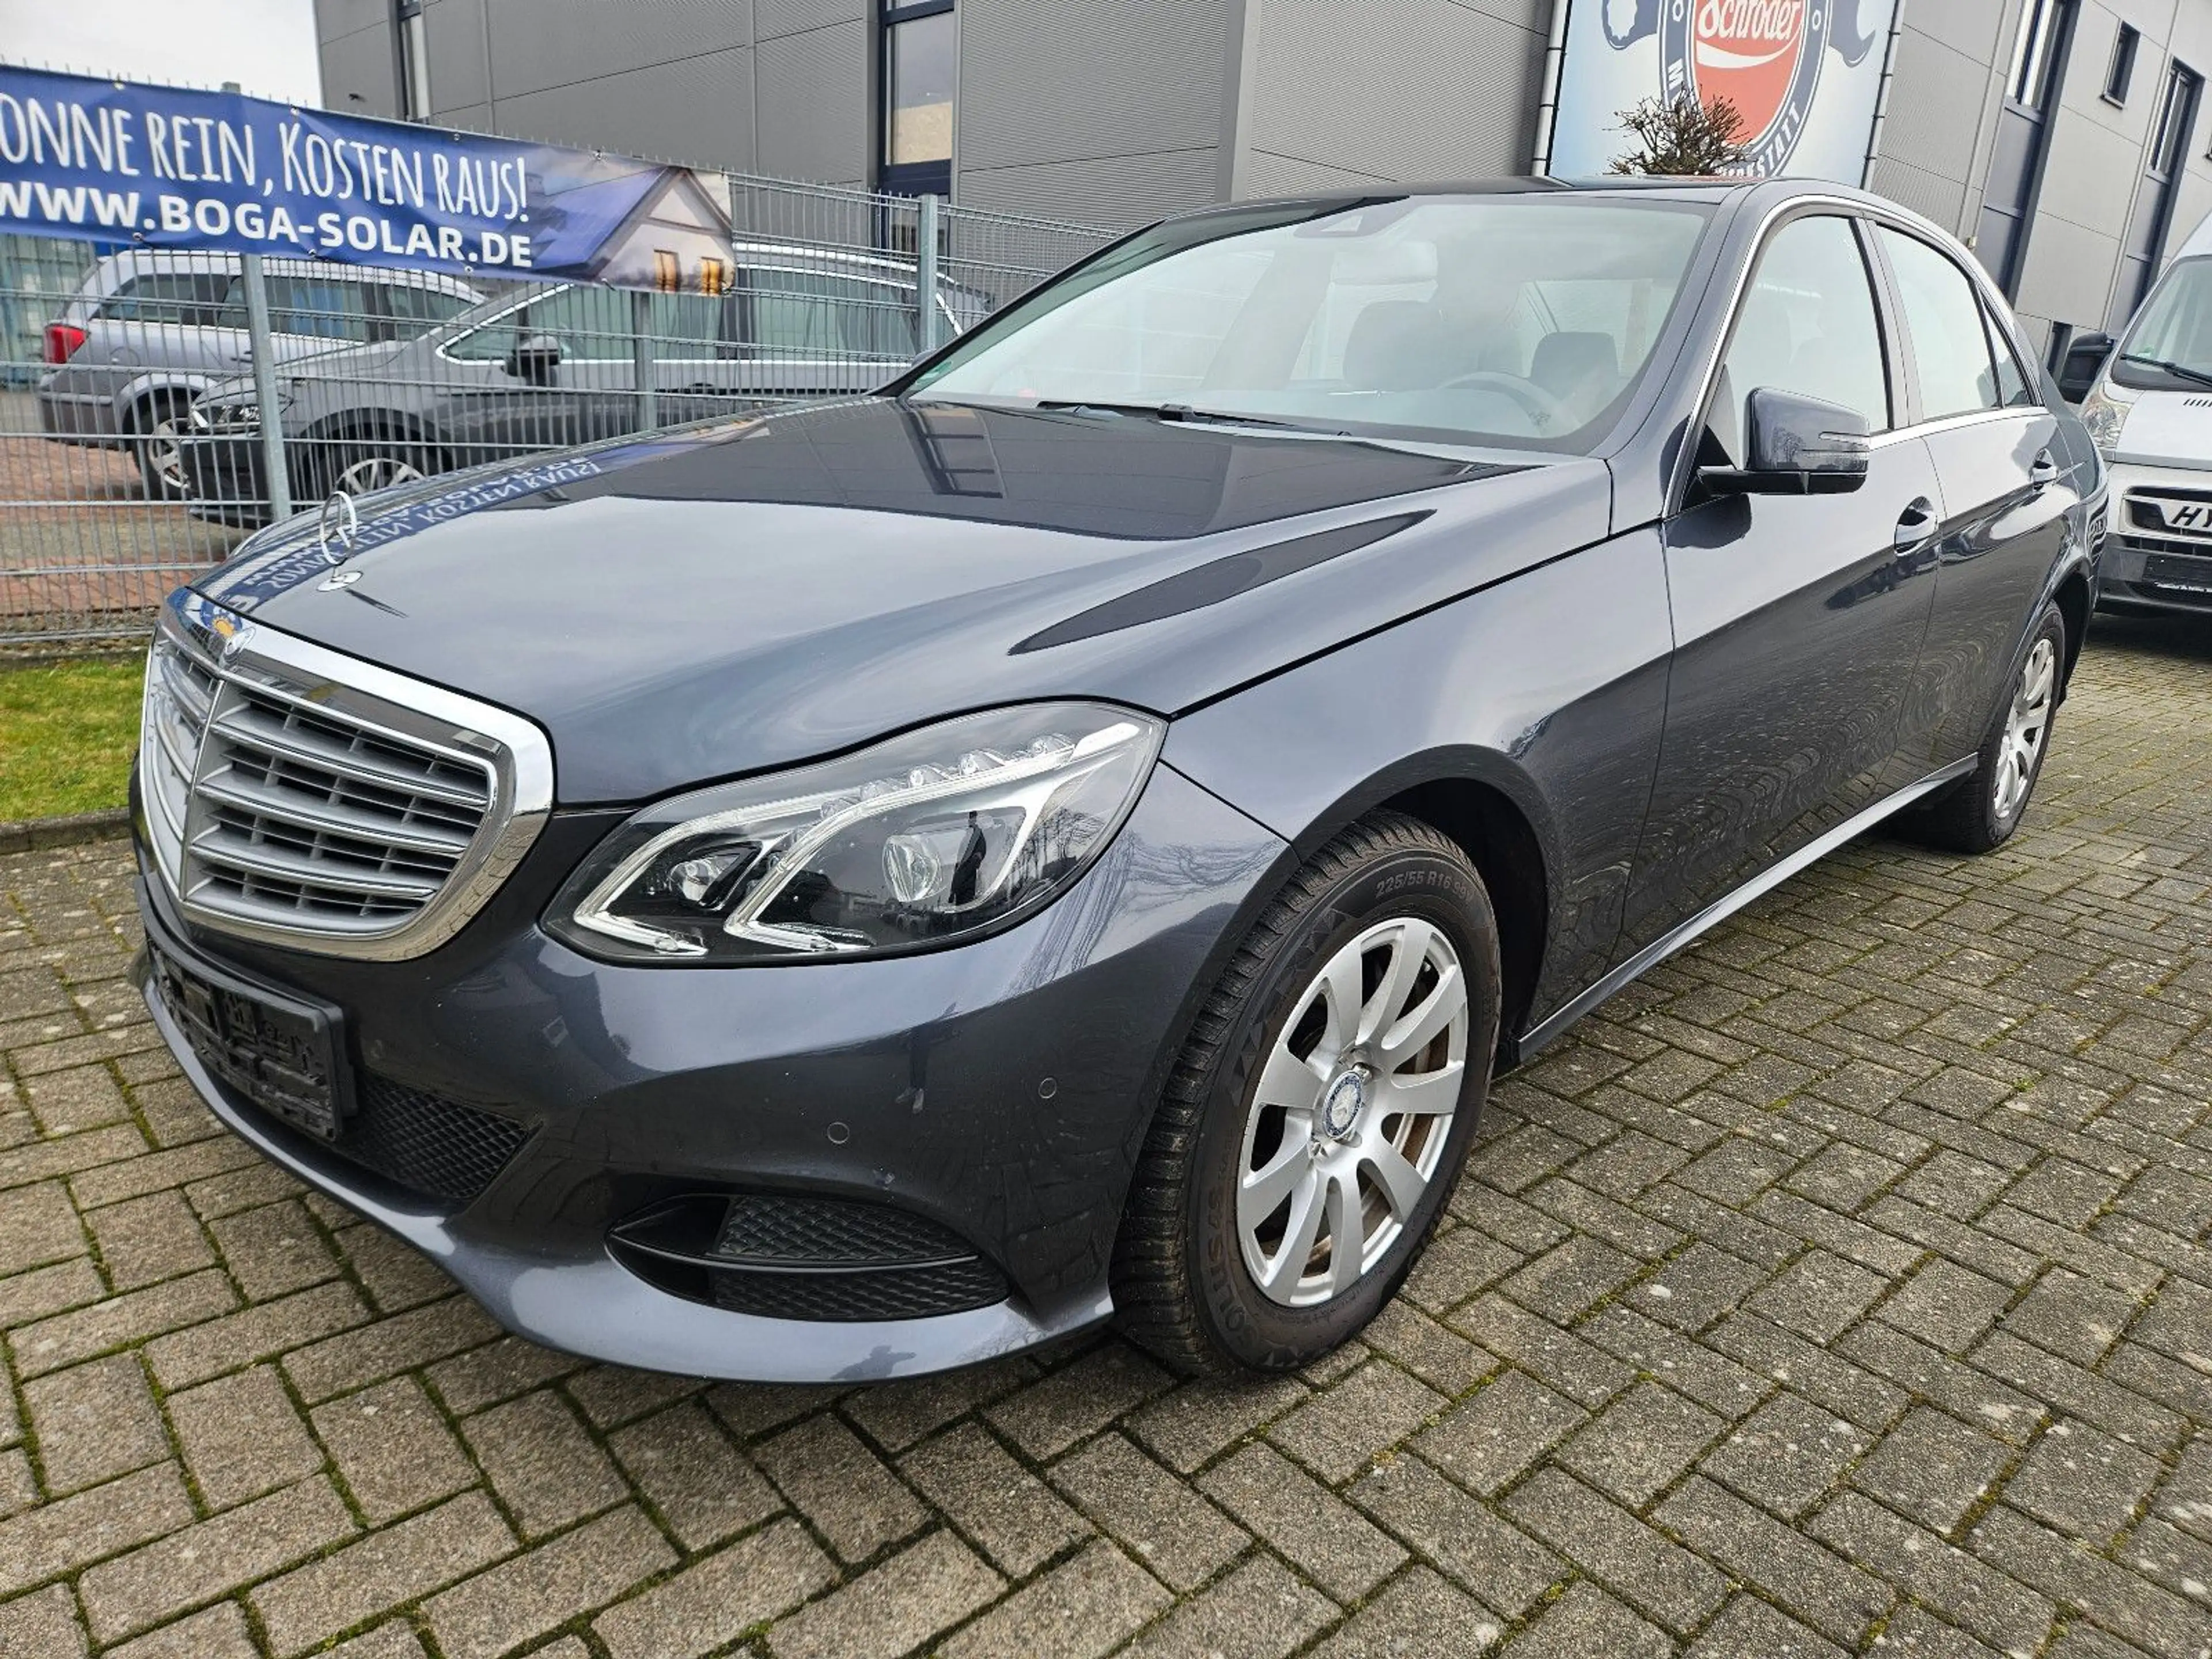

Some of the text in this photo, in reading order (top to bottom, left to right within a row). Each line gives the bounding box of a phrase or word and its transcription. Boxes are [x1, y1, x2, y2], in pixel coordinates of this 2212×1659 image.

[146, 111, 274, 196] REIN,
[279, 122, 424, 209] KOSTEN
[432, 153, 529, 223] RAUS!
[0, 180, 532, 268] WWW.BOGA-SOLAR.DE
[1375, 870, 1425, 899] 225/55
[1426, 870, 1452, 890] R16
